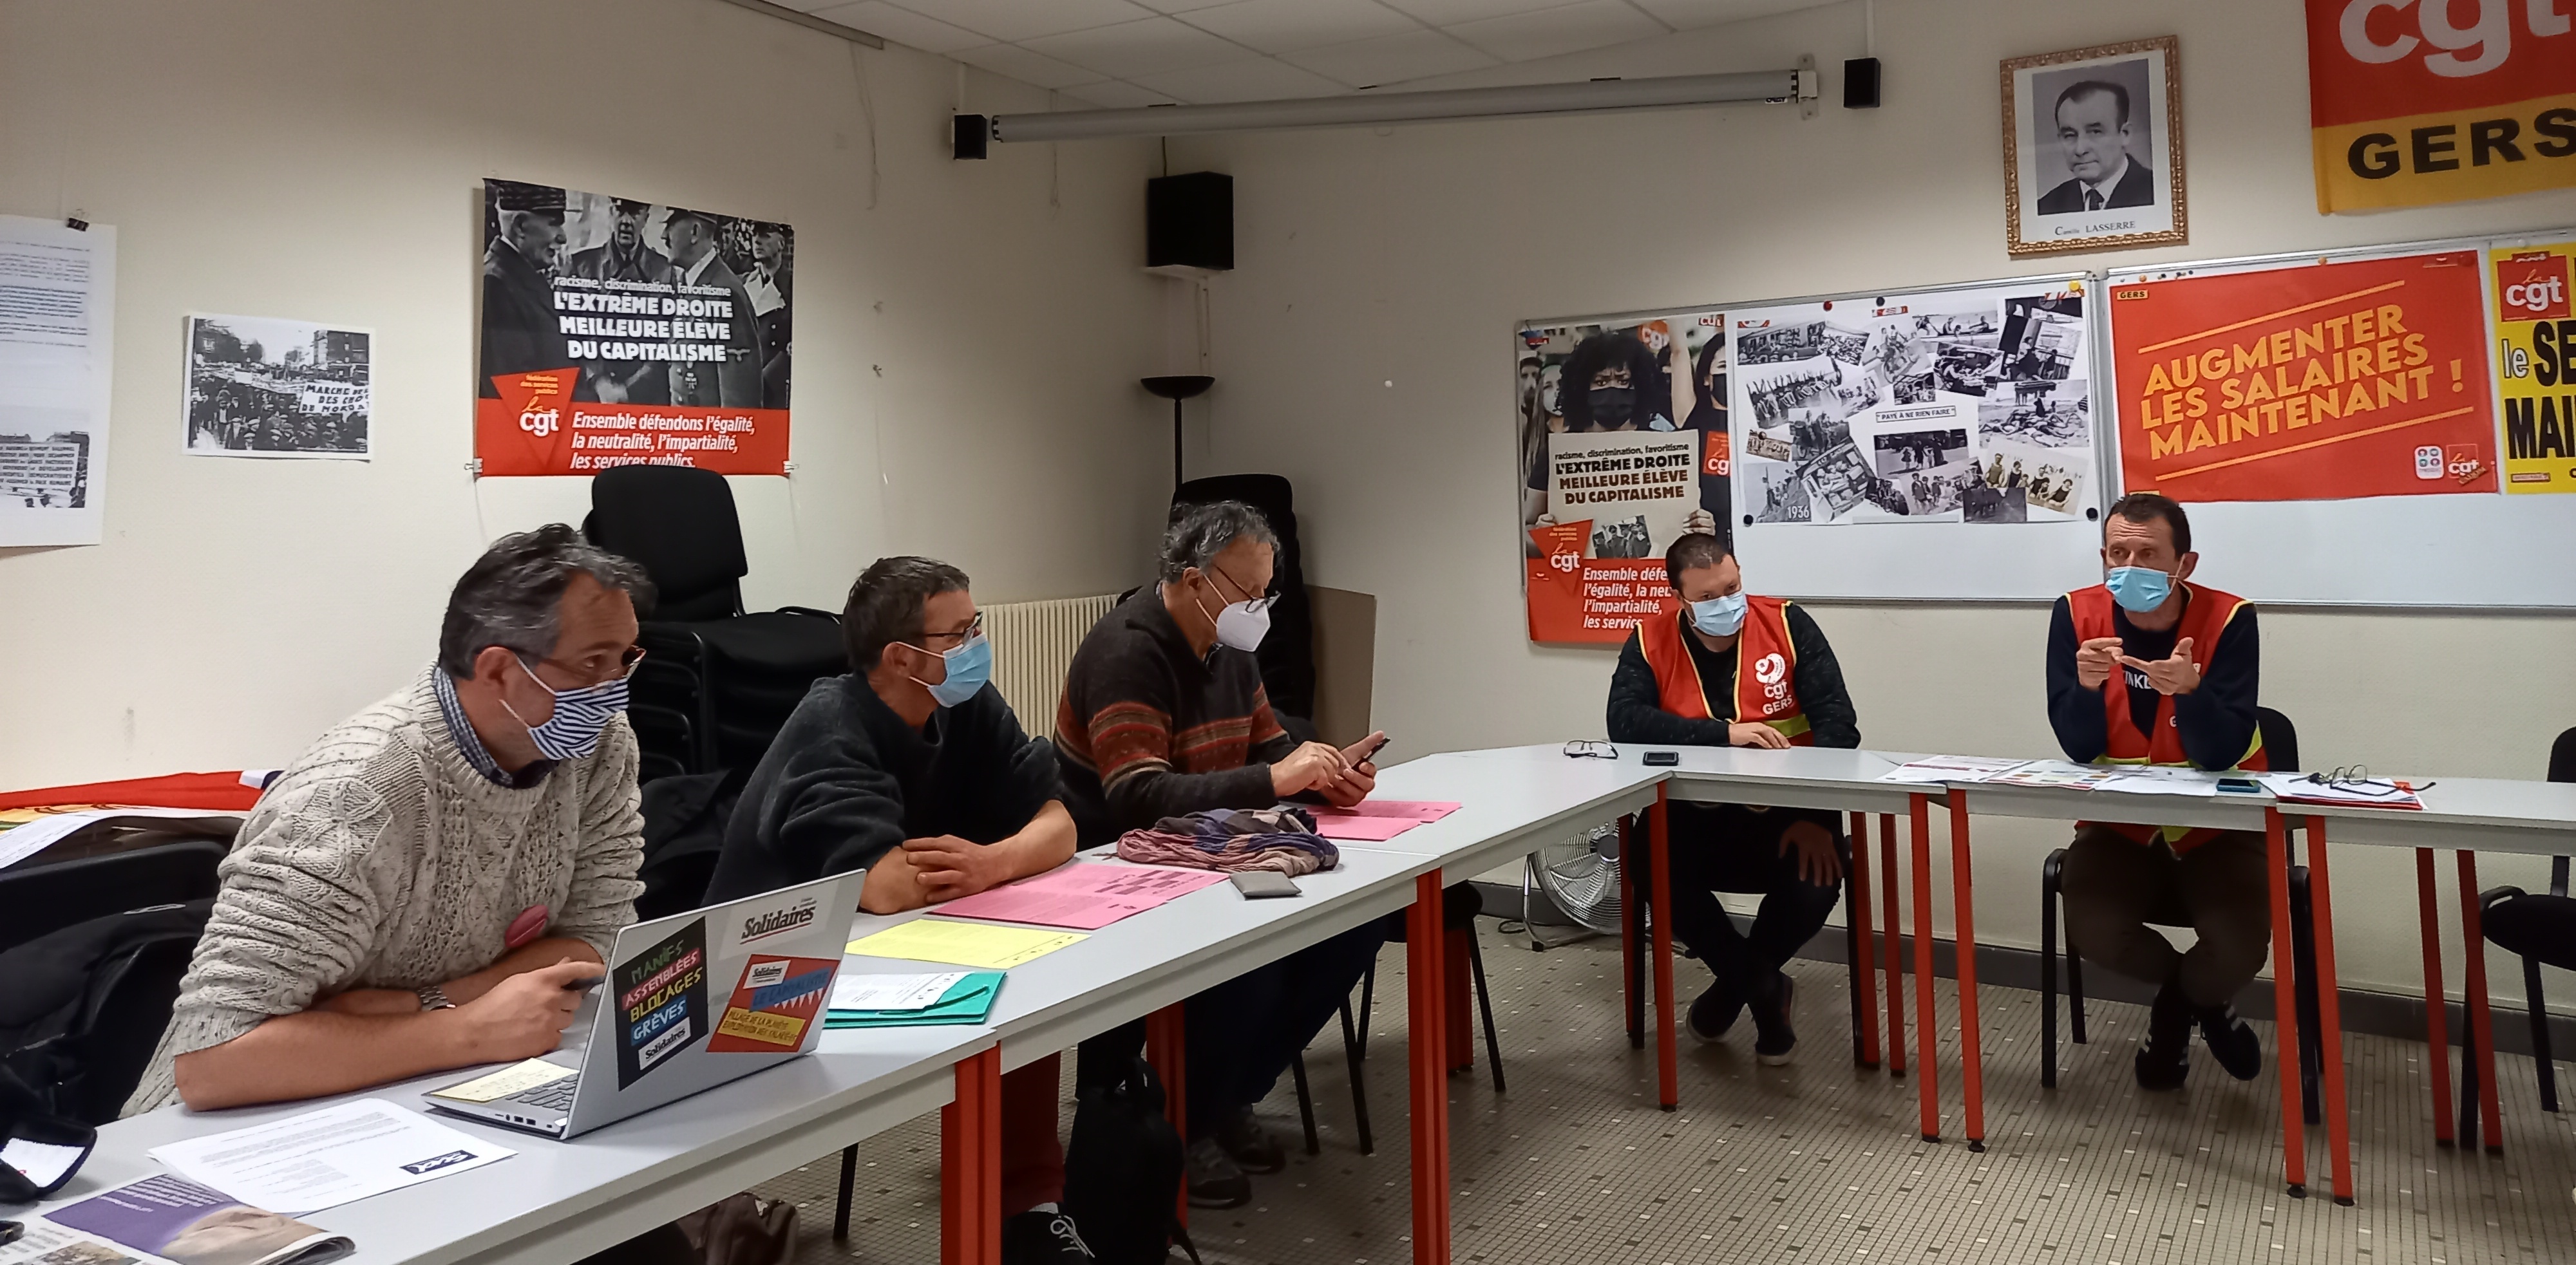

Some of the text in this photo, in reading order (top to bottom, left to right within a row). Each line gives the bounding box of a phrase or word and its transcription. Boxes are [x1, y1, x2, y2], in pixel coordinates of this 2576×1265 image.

[2347, 108, 2576, 180] GERS
[2086, 221, 2136, 232] LASSERRE
[554, 276, 731, 296] racisme, discrimination, favoritisme
[2506, 276, 2563, 311] cgt
[554, 292, 733, 317] L'EXTRÊME DROITE
[559, 315, 731, 339] MEILLEURE ÉLÈVE
[567, 340, 726, 361] DU CAPITALISME
[2143, 304, 2407, 396] AUGMENTER
[2502, 339, 2529, 379] le
[305, 385, 350, 395] MARCHE
[2141, 333, 2429, 429] LES SALAIRES
[520, 409, 559, 436] cgt
[572, 411, 755, 435] Ensemble défendons l'égalité,
[2150, 365, 2434, 460] MAINTENANT
[2505, 396, 2576, 459] MAI
[571, 431, 738, 453] la neutralité, l'impartialité,
[1555, 444, 1689, 460] racisme, discrimination, favoritisme
[570, 453, 591, 469] les
[592, 453, 645, 469] services
[1556, 454, 1690, 474] L'EXTRÊME DROITE
[1560, 469, 1688, 489] MEILLEURE ÉLÈVE
[1565, 485, 1684, 504] DU CAPITALISME
[1787, 506, 1810, 519] 1936
[1551, 551, 1580, 572] cgt
[1583, 567, 1638, 581] Ensemble
[1583, 583, 1633, 599] l'égalité,
[1636, 583, 1647, 597] la
[1583, 599, 1662, 615] l'impartialité,
[1583, 615, 1600, 628] les
[1763, 695, 1792, 715] GERS
[741, 906, 816, 939] Solidaires
[631, 940, 684, 984] MANIFS
[626, 951, 698, 1007] ASSEMBLÉES
[630, 967, 703, 1023] BLOCAGES
[634, 999, 686, 1040] GRÈVES
[645, 1029, 685, 1060] Solidaires
